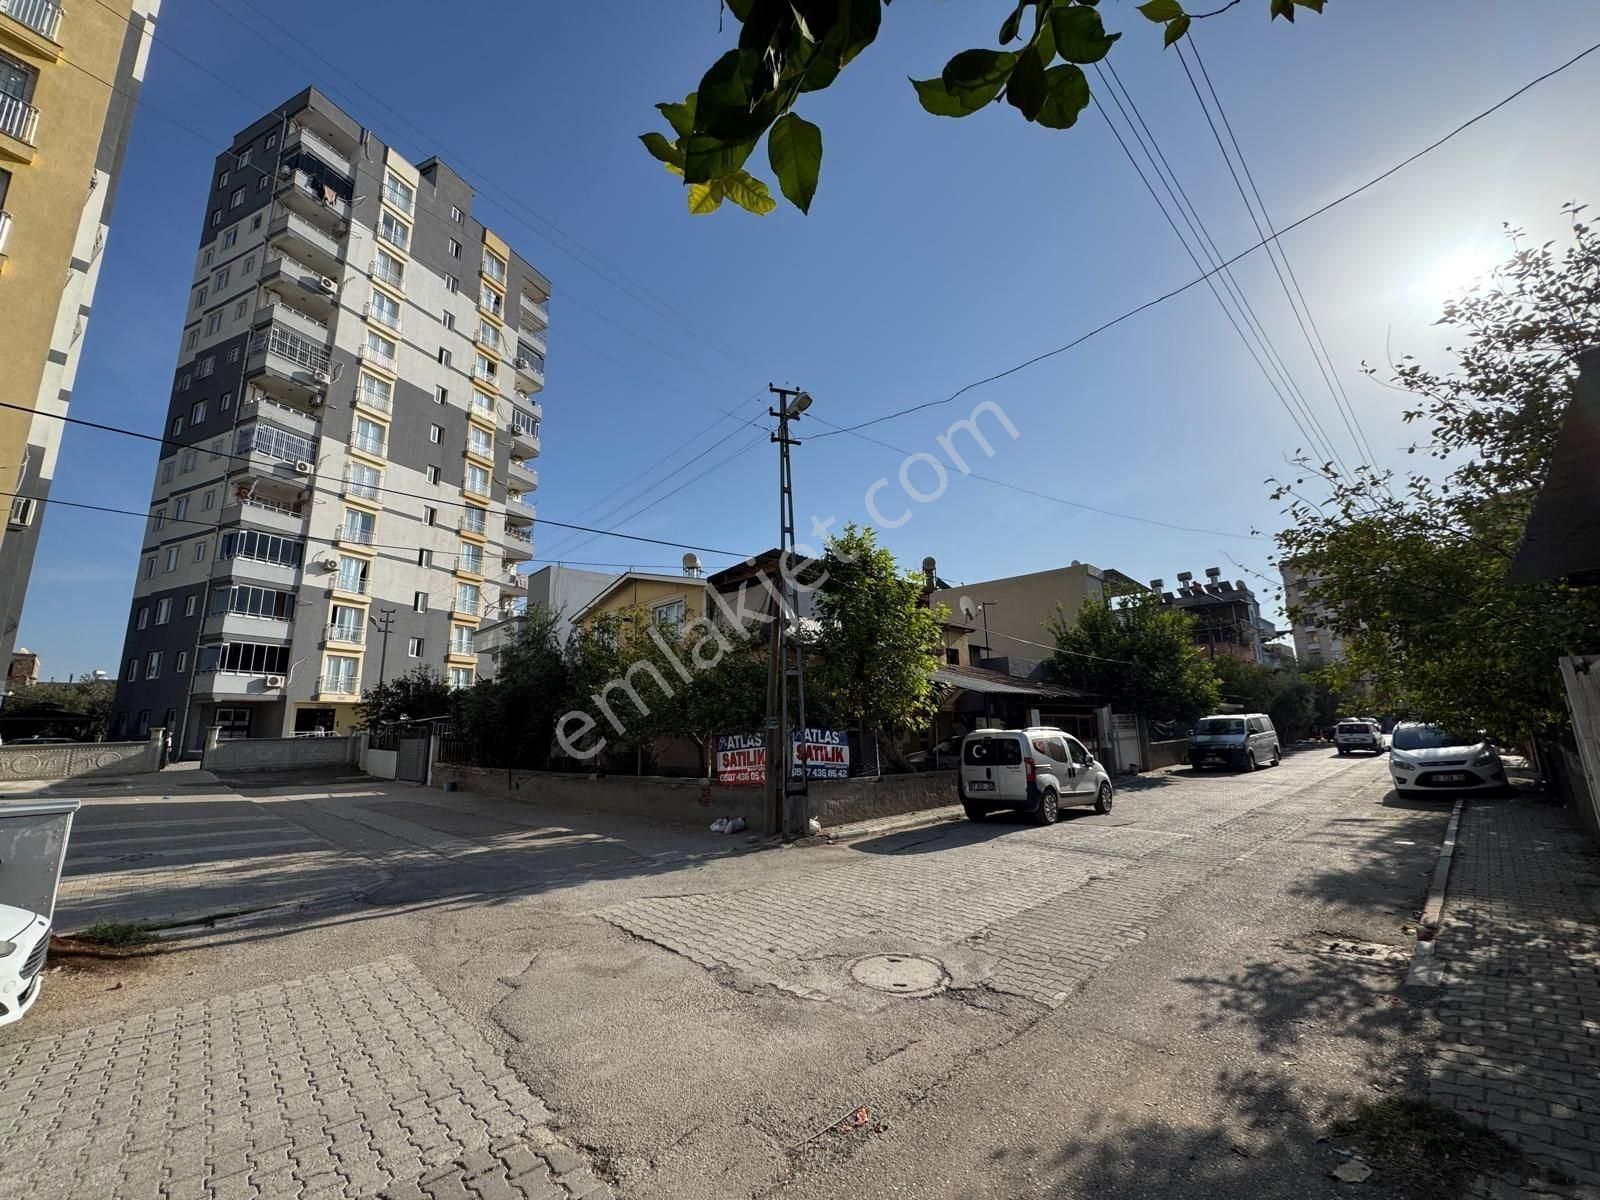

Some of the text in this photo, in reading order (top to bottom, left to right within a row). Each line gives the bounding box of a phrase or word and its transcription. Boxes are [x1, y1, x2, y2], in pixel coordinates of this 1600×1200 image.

[727, 732, 762, 750] ATLAS
[804, 728, 840, 744] ATLAS
[796, 743, 845, 763] SATILIK
[791, 767, 811, 777] 057
[812, 768, 827, 777] 436
[837, 769, 848, 778] 42
